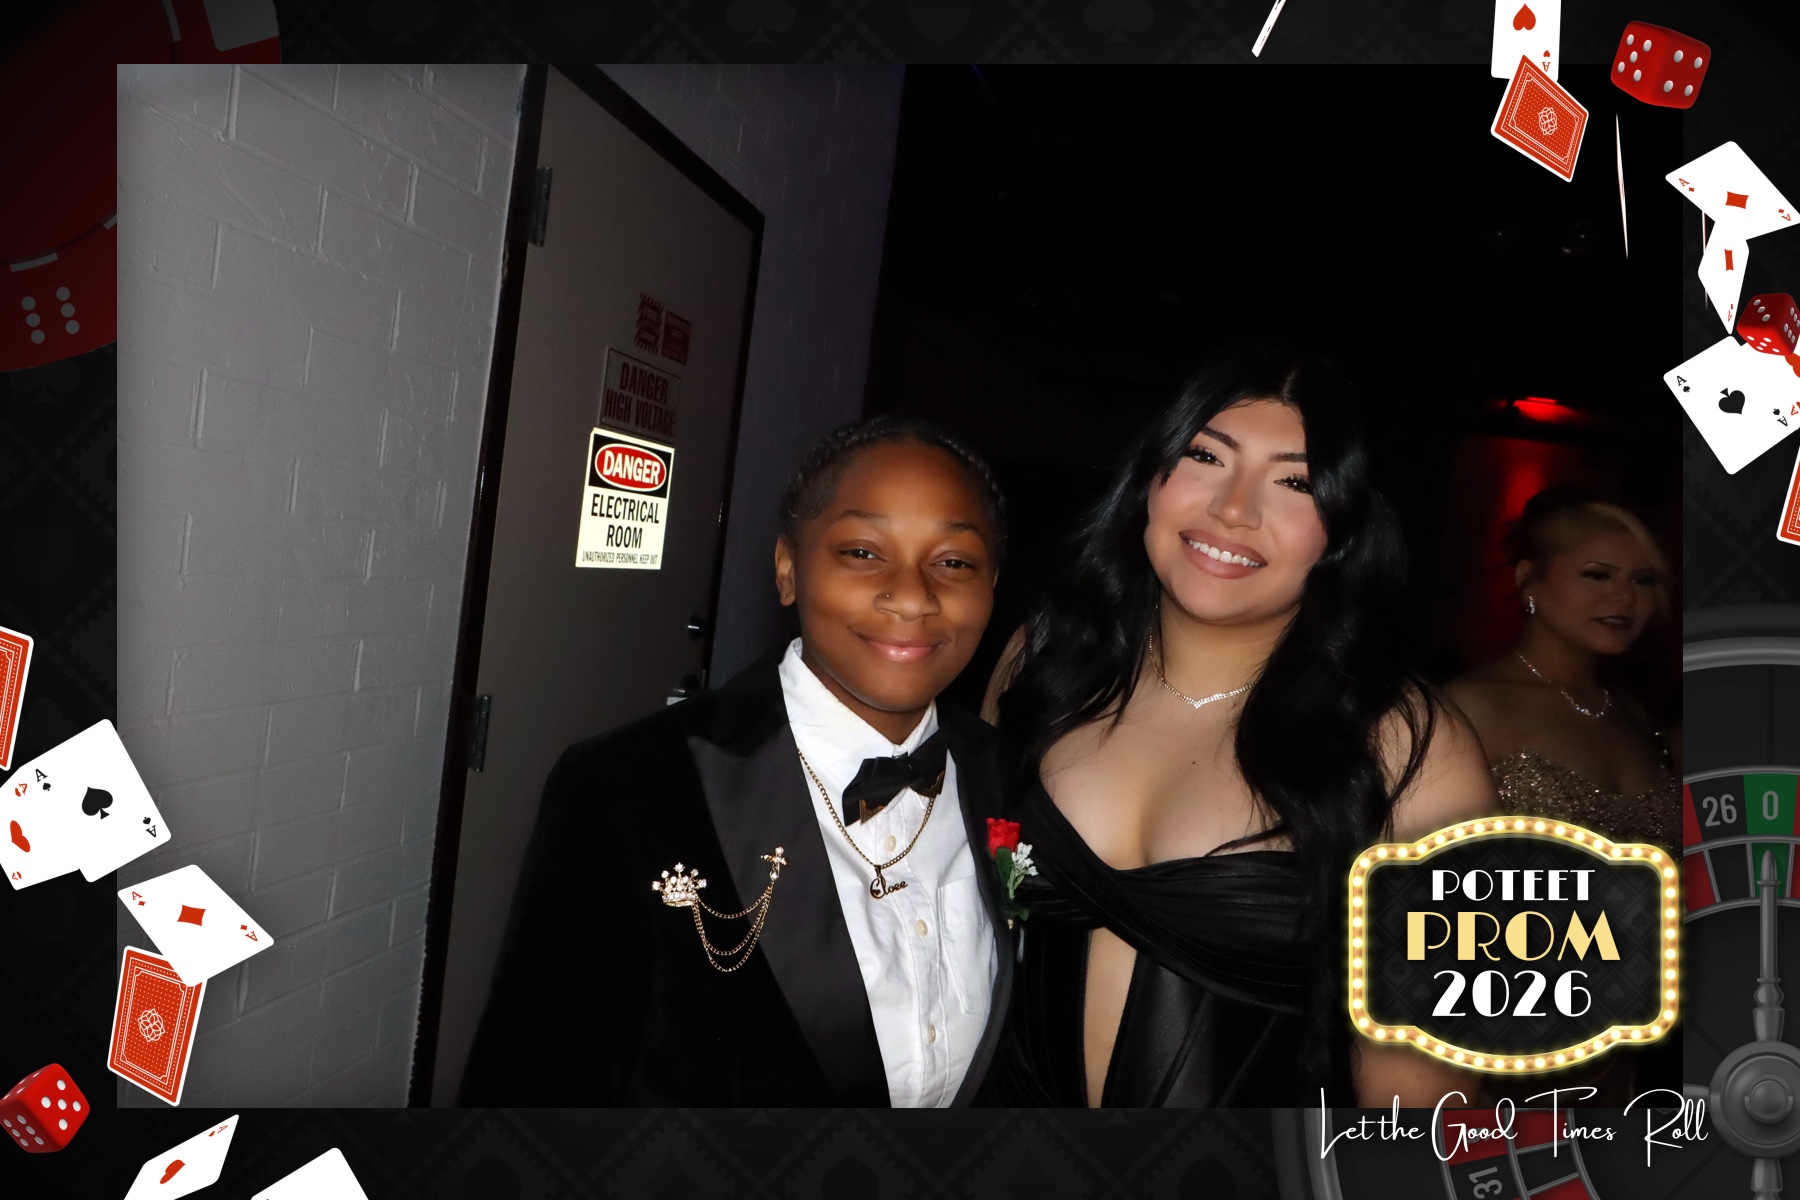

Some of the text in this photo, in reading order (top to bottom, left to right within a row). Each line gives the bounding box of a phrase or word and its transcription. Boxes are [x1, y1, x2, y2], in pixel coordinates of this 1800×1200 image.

[620, 361, 669, 405] DANGER
[603, 388, 676, 437] HIGH VOLTAGE
[603, 450, 661, 486] DANGER
[591, 493, 660, 524] ELECTRICAL
[606, 524, 643, 549] ROOM
[582, 550, 658, 565] UNAUTHORIZED PERSONNEL KEEP OUT
